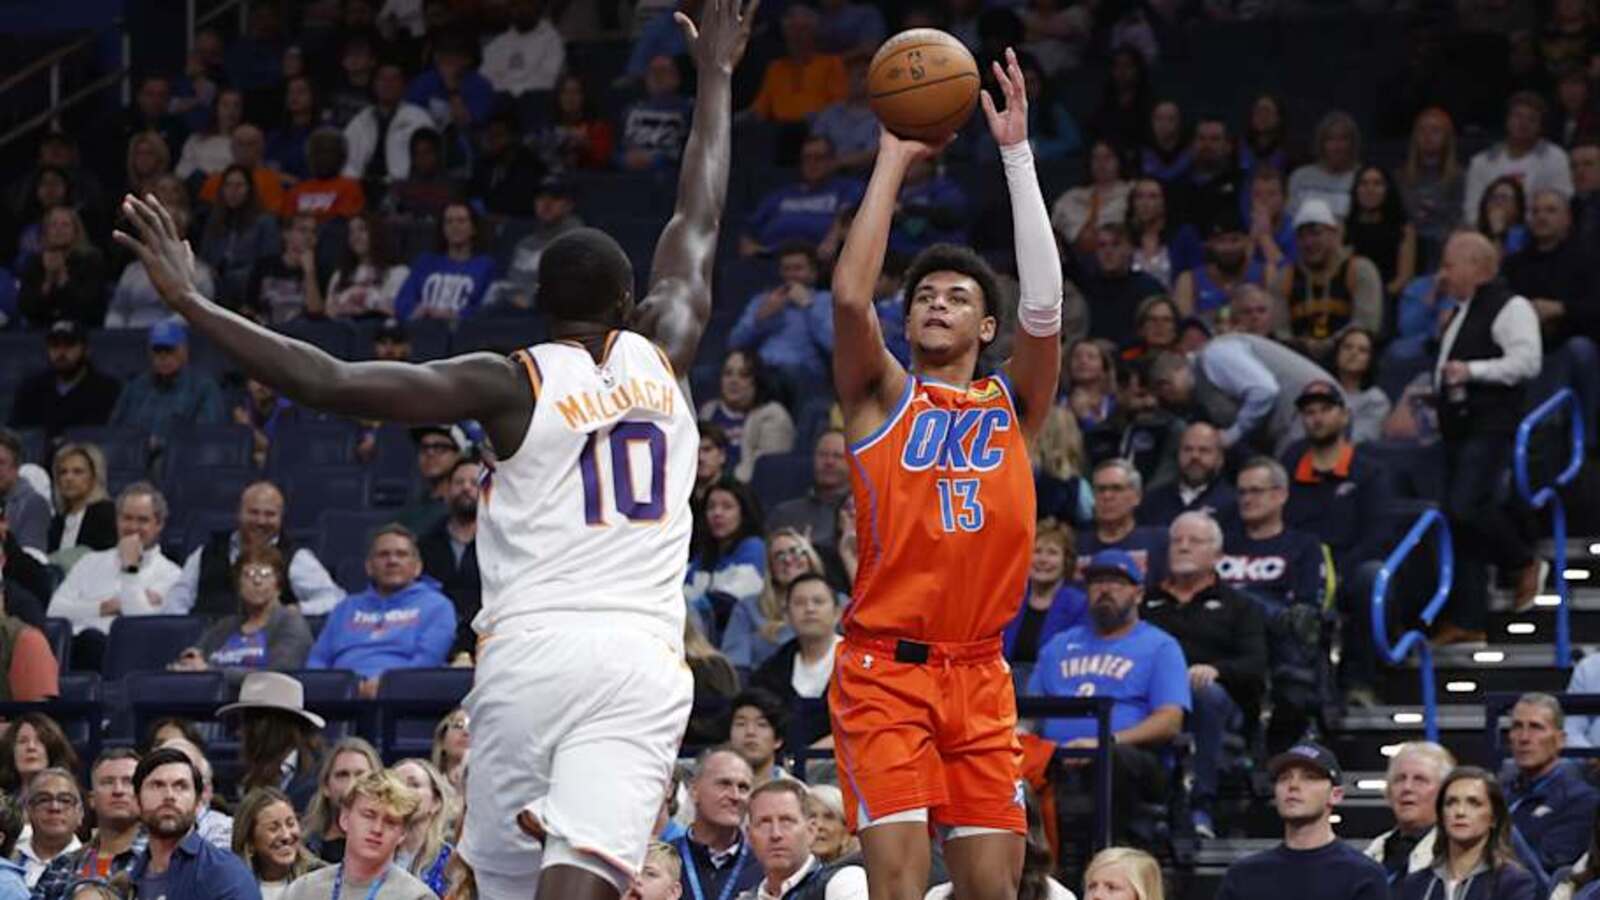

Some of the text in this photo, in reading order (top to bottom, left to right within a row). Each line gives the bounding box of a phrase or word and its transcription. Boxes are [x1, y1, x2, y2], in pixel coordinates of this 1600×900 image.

[421, 272, 474, 310] OKC
[554, 378, 675, 432] MALUACH
[901, 406, 1012, 471] OKC
[579, 420, 671, 527] 10
[936, 478, 985, 532] 13
[1215, 555, 1286, 580] OKC
[1060, 653, 1134, 680] THUNDER
